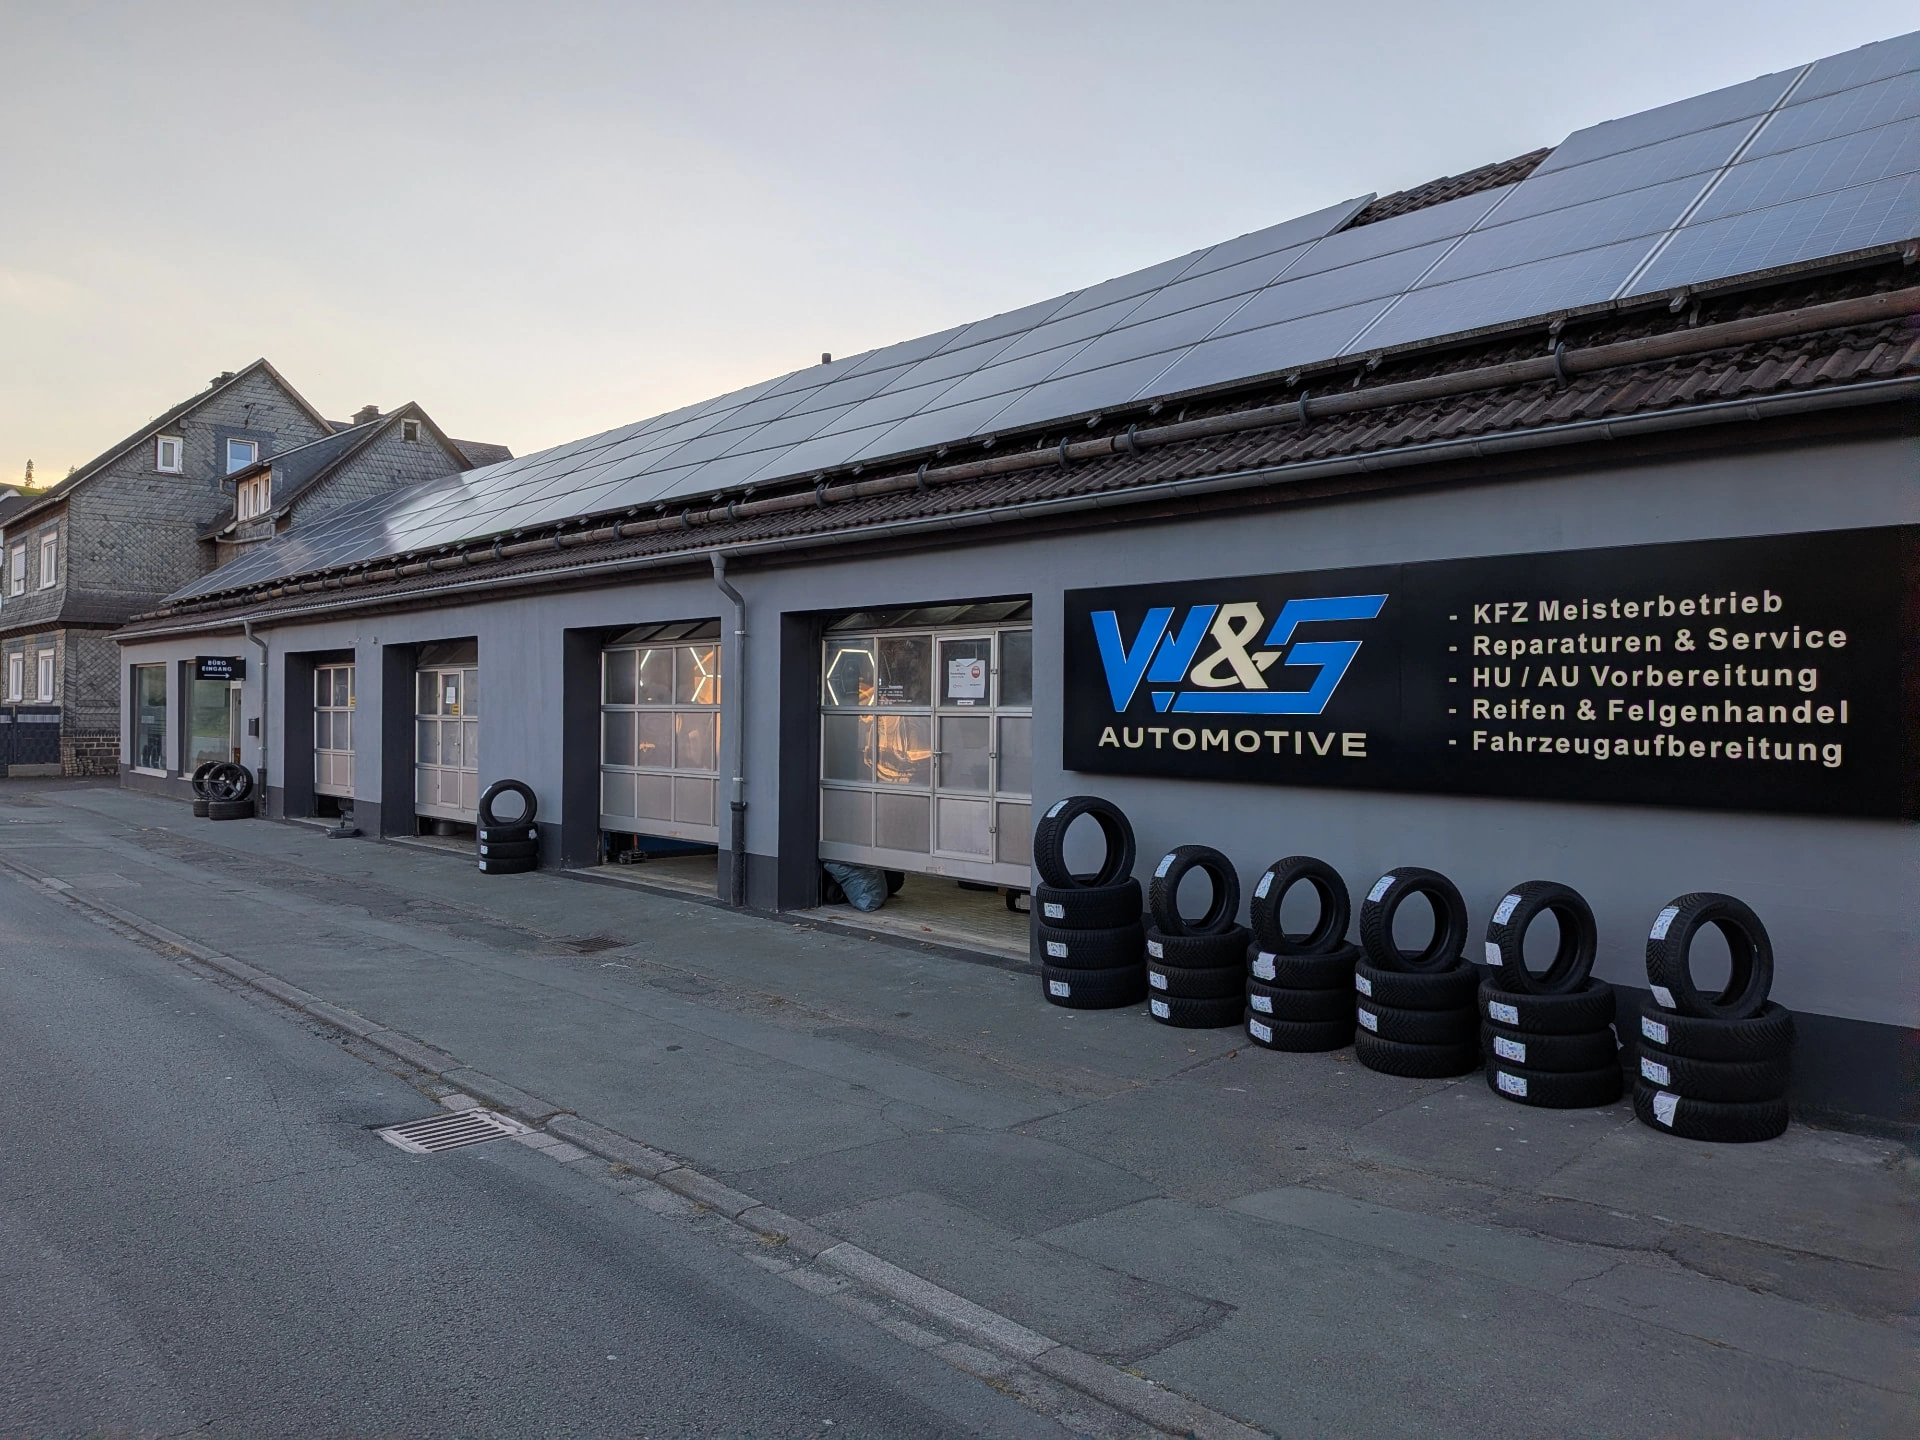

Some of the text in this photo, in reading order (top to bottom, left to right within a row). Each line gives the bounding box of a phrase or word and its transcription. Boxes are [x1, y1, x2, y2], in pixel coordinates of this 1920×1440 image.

[1473, 601, 1529, 625] KFZ
[1539, 589, 1783, 622] Meisterbetrieb
[1473, 632, 1661, 660] Reparaturen
[1674, 628, 1696, 652] &
[1708, 625, 1847, 651] Service
[1473, 666, 1511, 688] HU
[1521, 666, 1530, 688] /
[1537, 666, 1579, 687] AU
[1590, 663, 1817, 693] Vorbereitung
[1473, 698, 1565, 720] Reifen
[1576, 699, 1597, 721] &
[1608, 699, 1848, 728] Felgenhandel
[1098, 726, 1367, 758] AUTOMOTIVE
[1473, 730, 1842, 768] Fahrzeugaufbereitung
